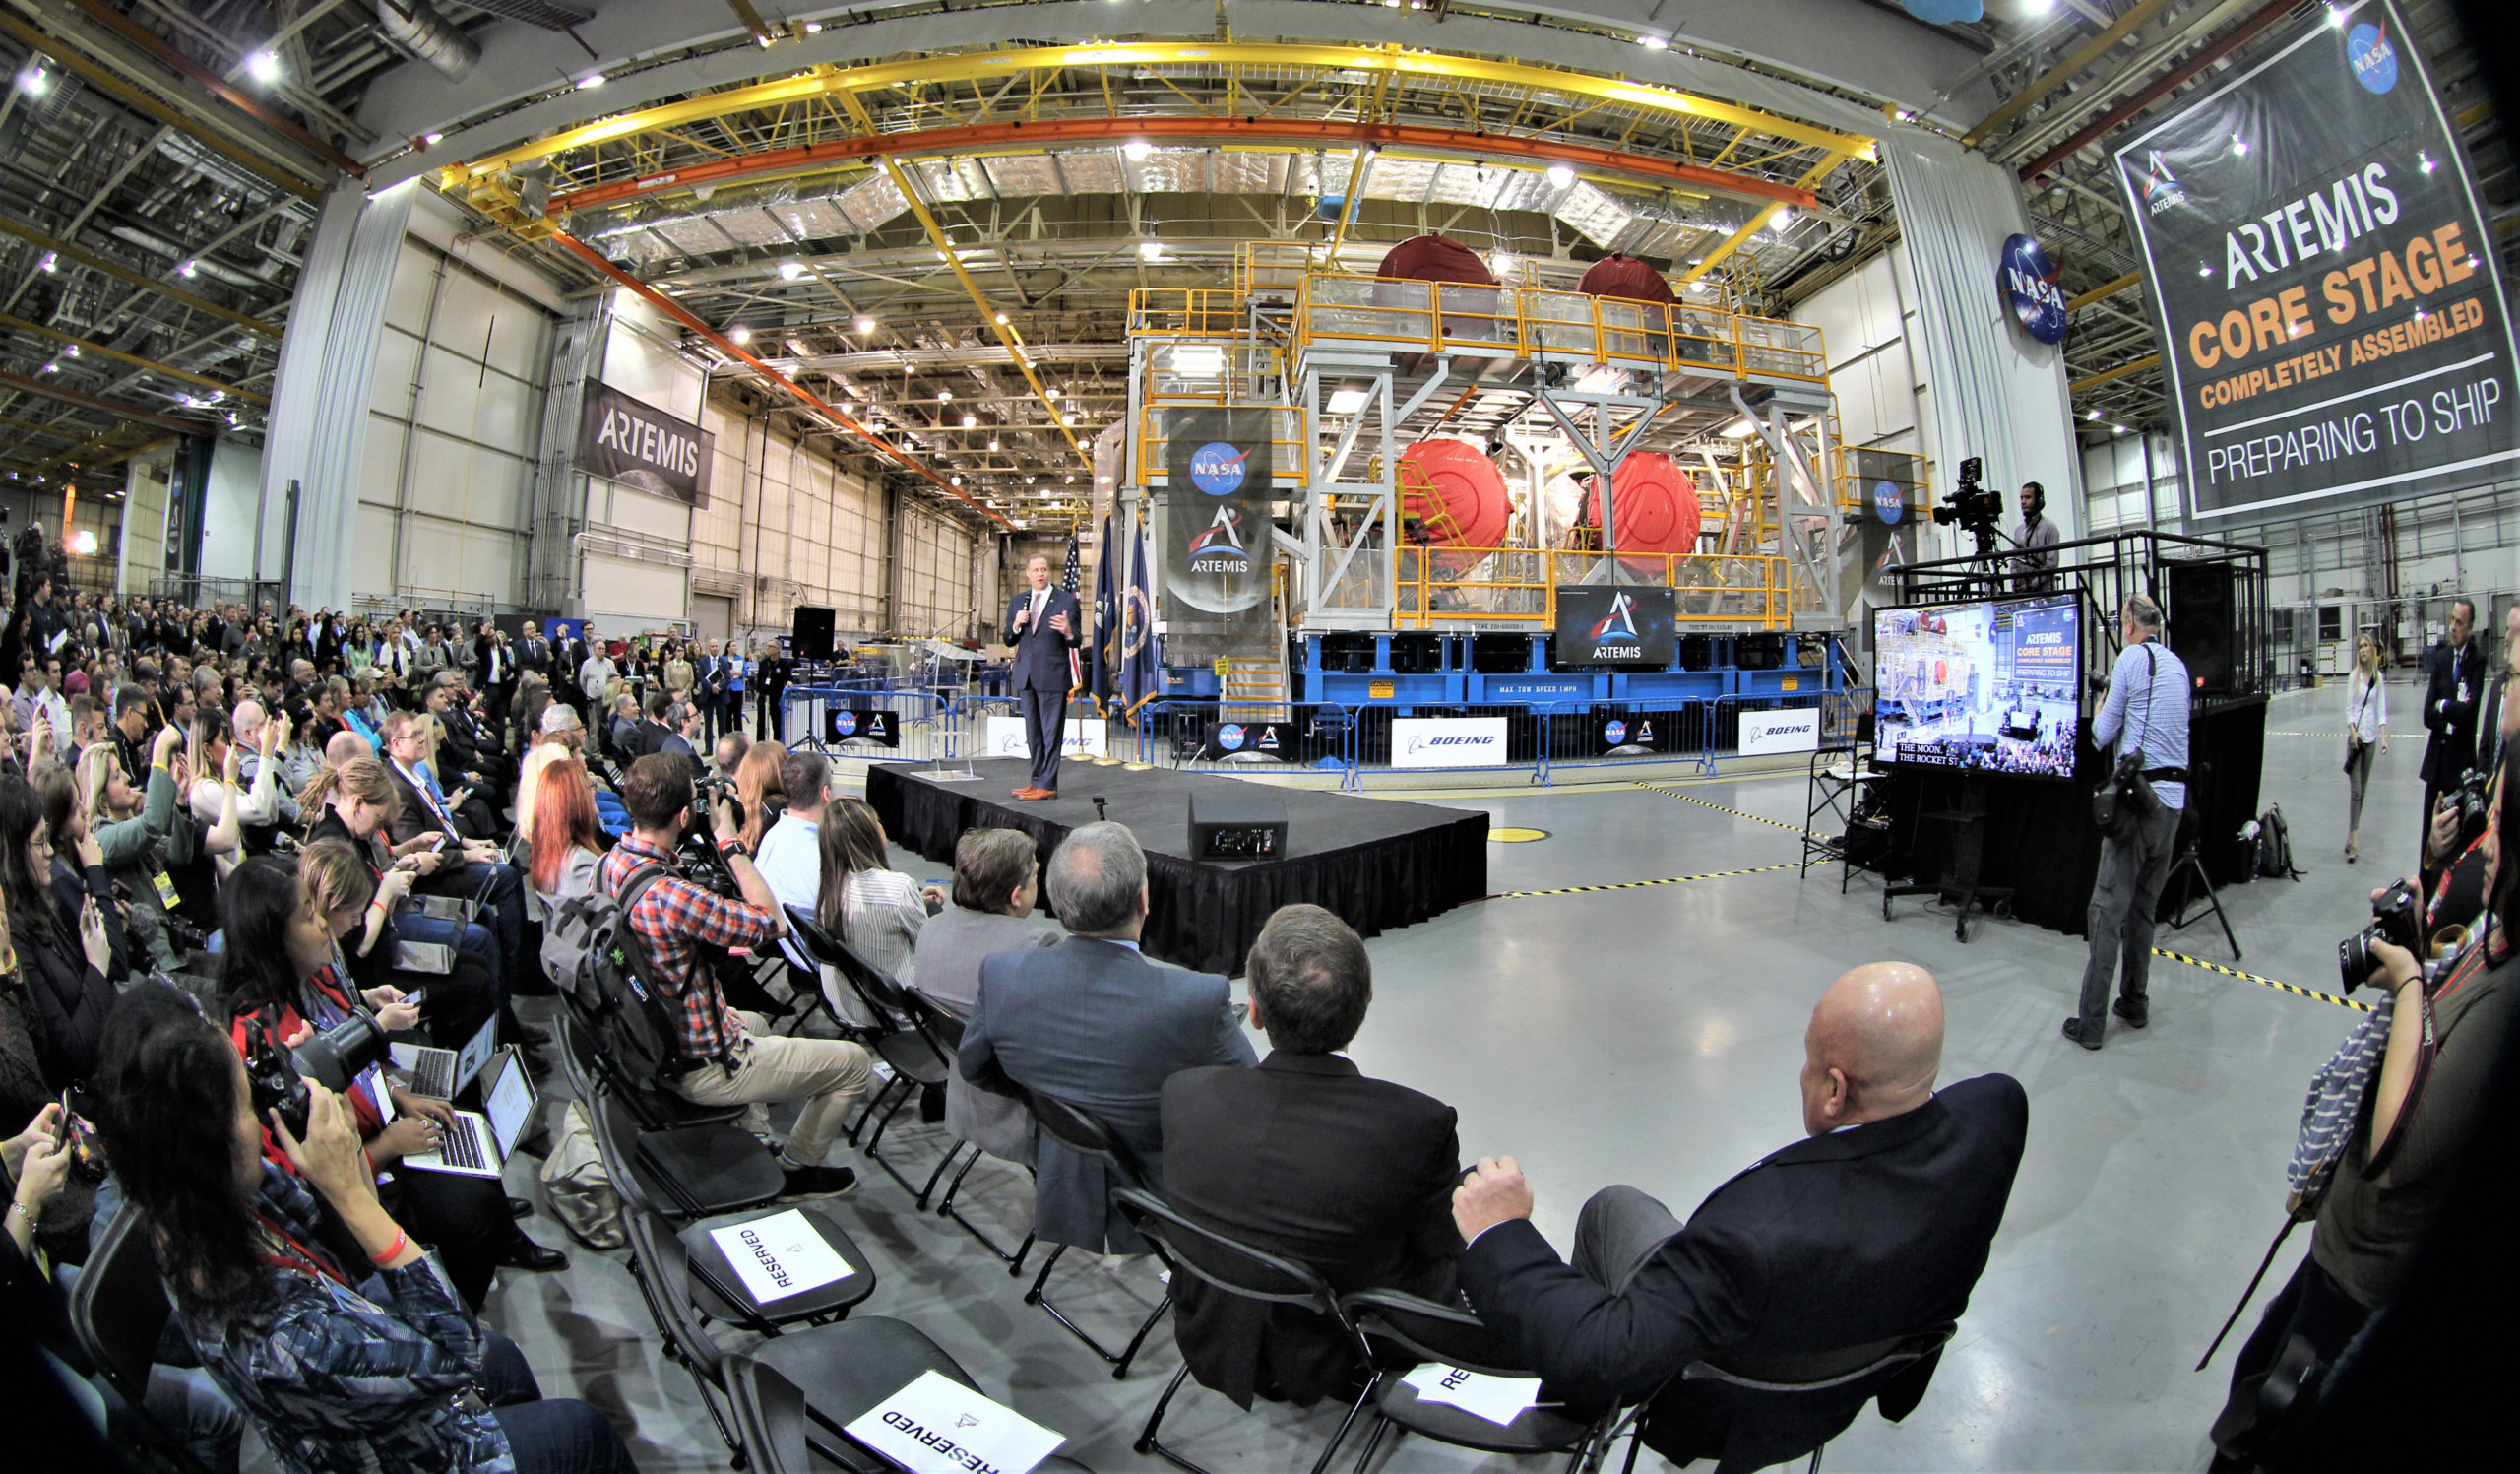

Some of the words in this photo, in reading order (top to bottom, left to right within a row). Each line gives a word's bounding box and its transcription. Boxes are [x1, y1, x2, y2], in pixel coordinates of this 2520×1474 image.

[2353, 42, 2392, 75] NASA
[2151, 191, 2185, 217] ARTEMIS
[2227, 162, 2399, 290] ARTEMIS
[2008, 267, 2065, 311] NASA
[2189, 284, 2315, 369] CORE
[2322, 221, 2475, 325] STAGE
[2200, 344, 2342, 410] COMPLETELY
[2351, 297, 2484, 367] ASSEMBLED
[2208, 412, 2377, 485] PREPARING
[2379, 398, 2426, 446] TO
[2432, 377, 2501, 435] SHIP
[598, 408, 699, 478] ARTEMIS
[1195, 463, 1242, 476] NASA
[1875, 496, 1901, 509] NASA
[1191, 560, 1248, 573] ARTEMIS
[1878, 575, 1905, 586] ARTEM
[2025, 632, 2062, 645] ARTEMIS
[1593, 646, 1641, 659] ARTEMIS
[2017, 647, 2041, 656] CORE
[2043, 646, 2072, 656] STAGE
[1766, 724, 1811, 736] BOEING
[1429, 736, 1494, 745] BOEING
[1900, 743, 1916, 752] THE
[1917, 744, 1944, 754] MOON.
[1899, 753, 1916, 762] THE
[1917, 754, 1947, 765] ROCKET
[740, 1229, 794, 1288] RESERVED
